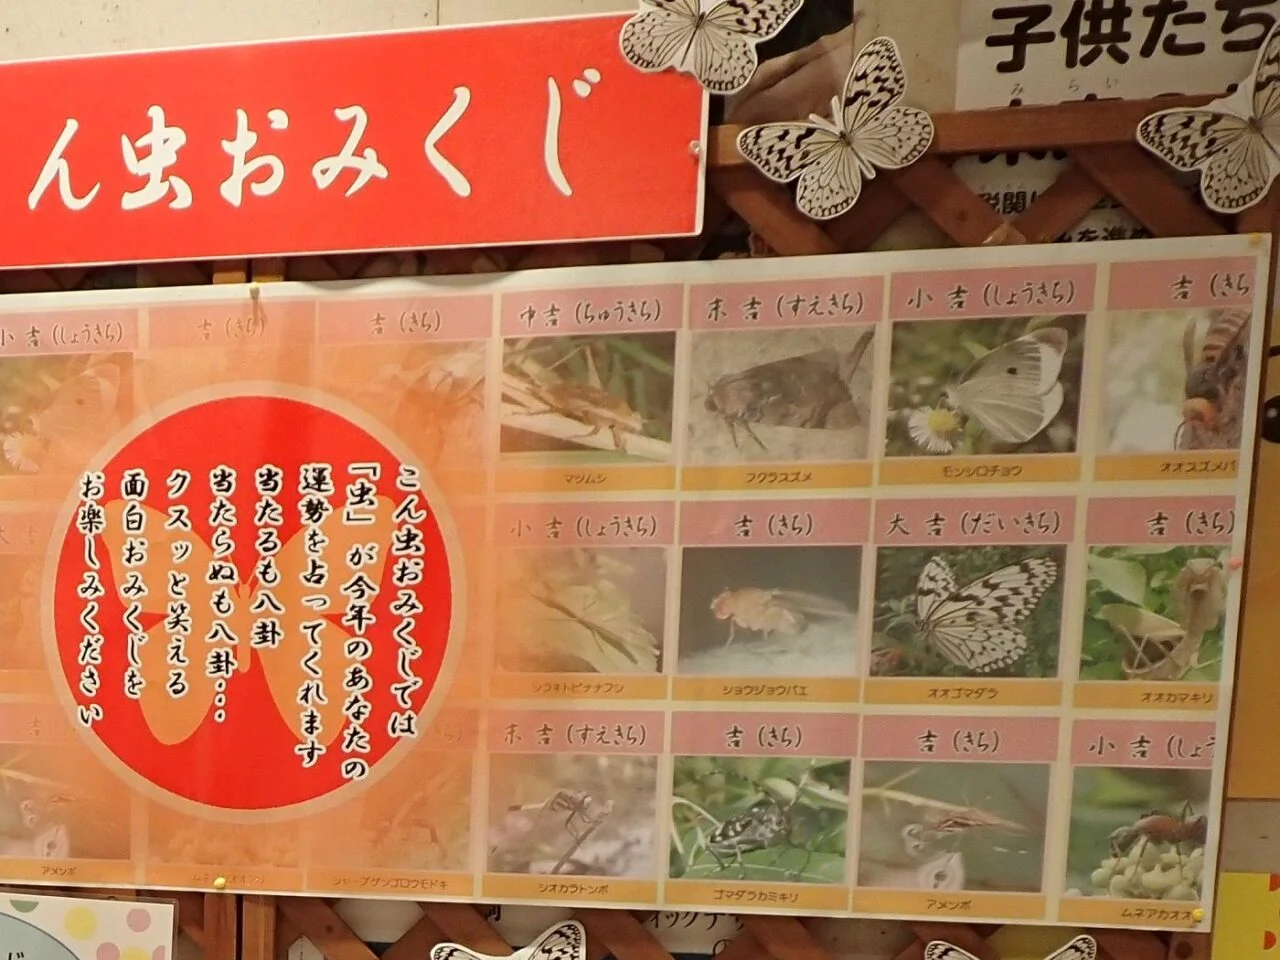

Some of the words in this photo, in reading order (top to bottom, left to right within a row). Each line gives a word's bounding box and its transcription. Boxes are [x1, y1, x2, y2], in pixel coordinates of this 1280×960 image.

[985, 0, 1275, 73] 子供たち
[79, 473, 104, 724] お楽しみください
[121, 471, 147, 696] 面白おみくじを
[164, 470, 192, 696] クスッと笑える
[252, 467, 282, 646] 当たるも八卦
[297, 467, 332, 765] 運勢を占ってくれます
[389, 467, 425, 735] こん虫おみくじでは
